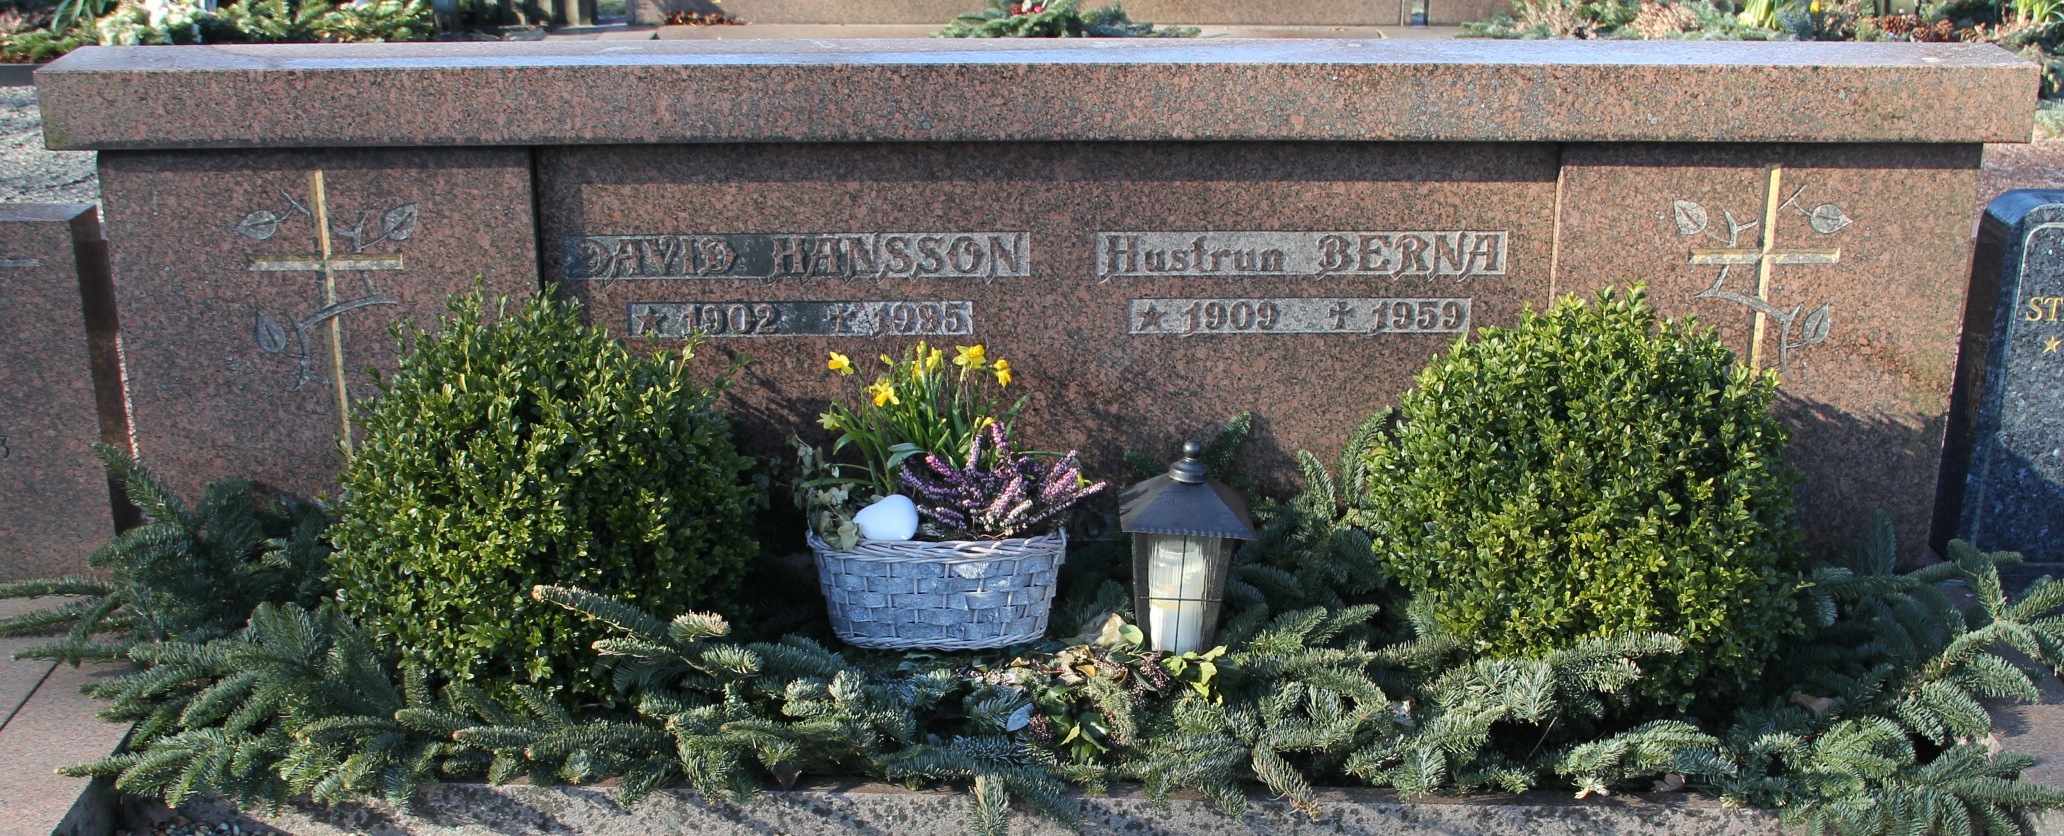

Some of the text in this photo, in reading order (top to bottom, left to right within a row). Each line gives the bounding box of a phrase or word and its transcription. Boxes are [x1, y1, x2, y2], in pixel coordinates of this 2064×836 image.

[575, 232, 1020, 289] DAVID HANSSON
[1098, 231, 1500, 284] Hustrun BERNA
[680, 303, 777, 338] 1902
[1182, 301, 1467, 337] 1909 1959
[2025, 296, 2064, 321] ST
